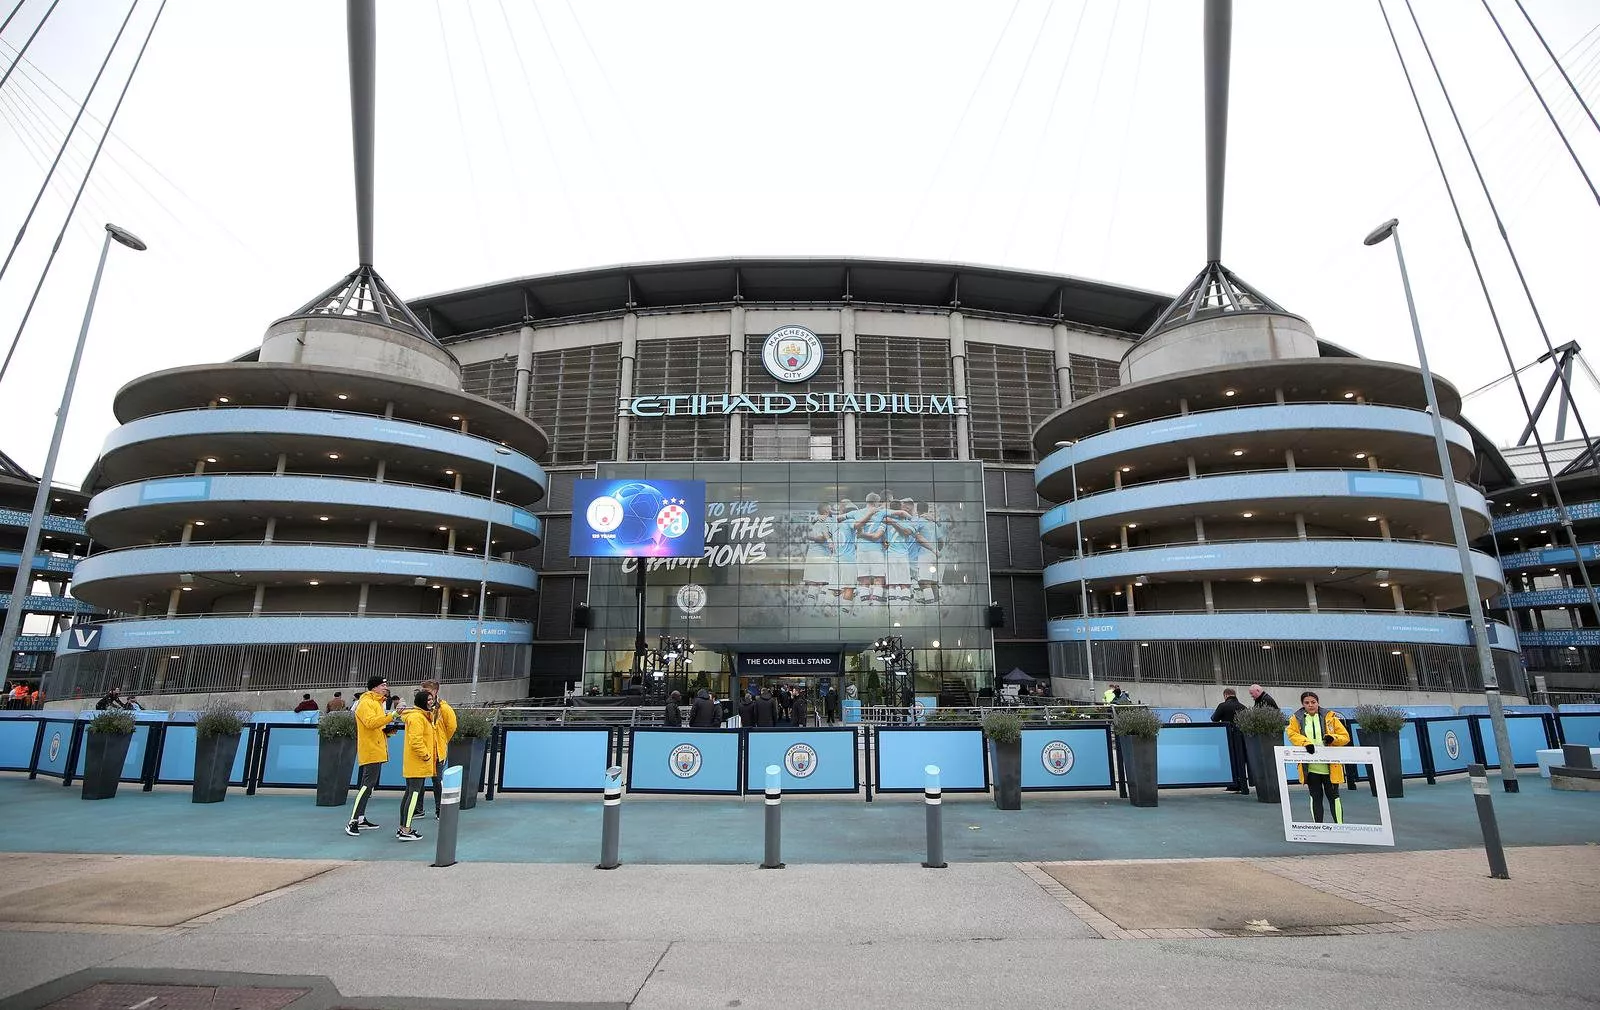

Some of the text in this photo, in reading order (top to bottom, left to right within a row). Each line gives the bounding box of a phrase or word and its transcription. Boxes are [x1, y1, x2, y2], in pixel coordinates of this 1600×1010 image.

[769, 330, 816, 347] MANCHESTER
[632, 392, 955, 417] ETIHAD STADIUM
[708, 500, 759, 517] TO THE
[731, 516, 775, 540] THE
[74, 629, 98, 647] V
